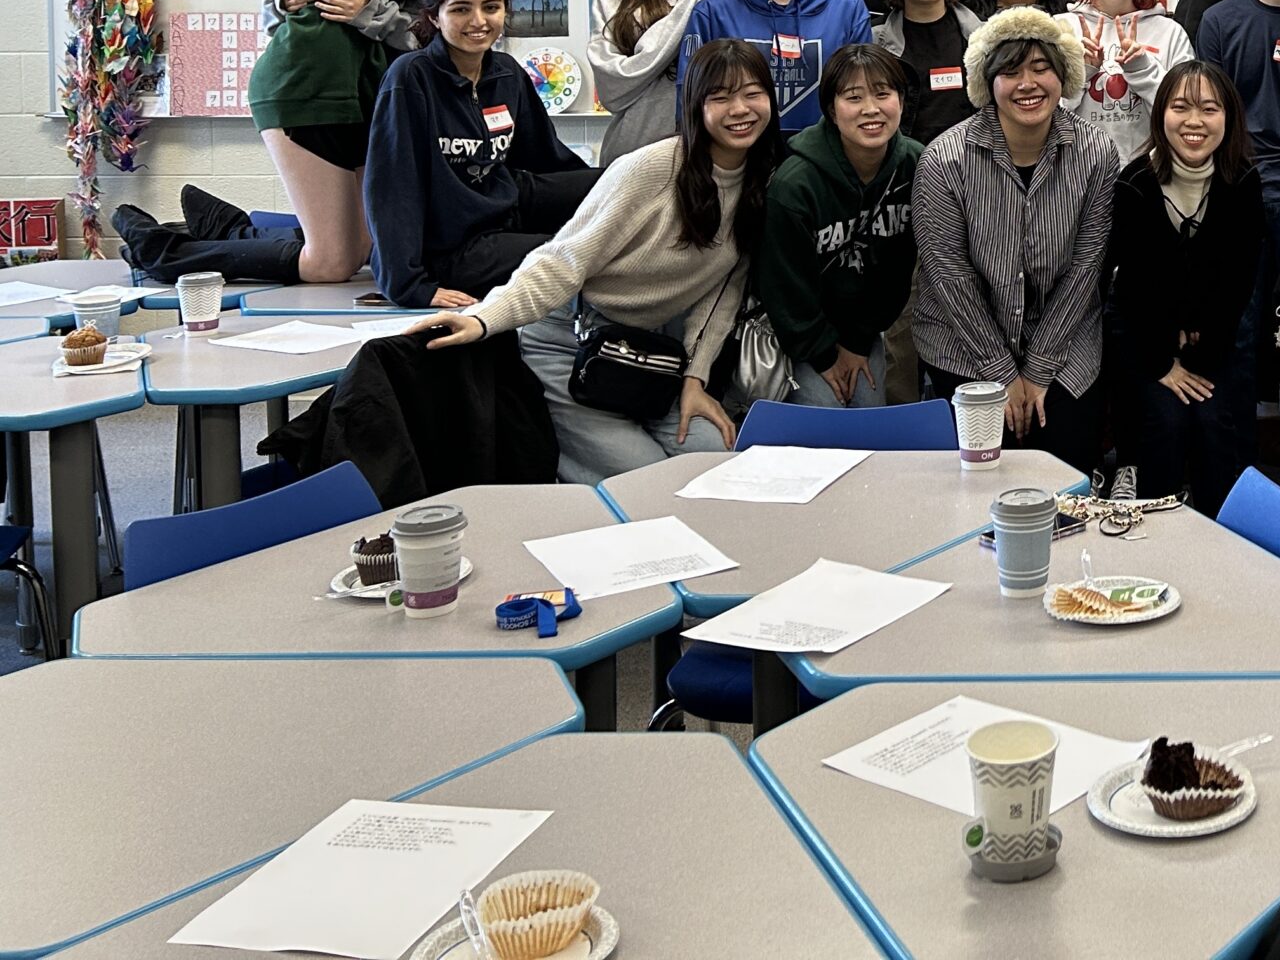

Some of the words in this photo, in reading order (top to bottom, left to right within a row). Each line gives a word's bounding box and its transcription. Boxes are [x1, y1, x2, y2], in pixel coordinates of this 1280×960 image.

[226, 17, 235, 26] ラ
[244, 17, 253, 26] ヤ
[226, 55, 234, 64] ル
[438, 137, 484, 156] new
[981, 452, 994, 460] ON
